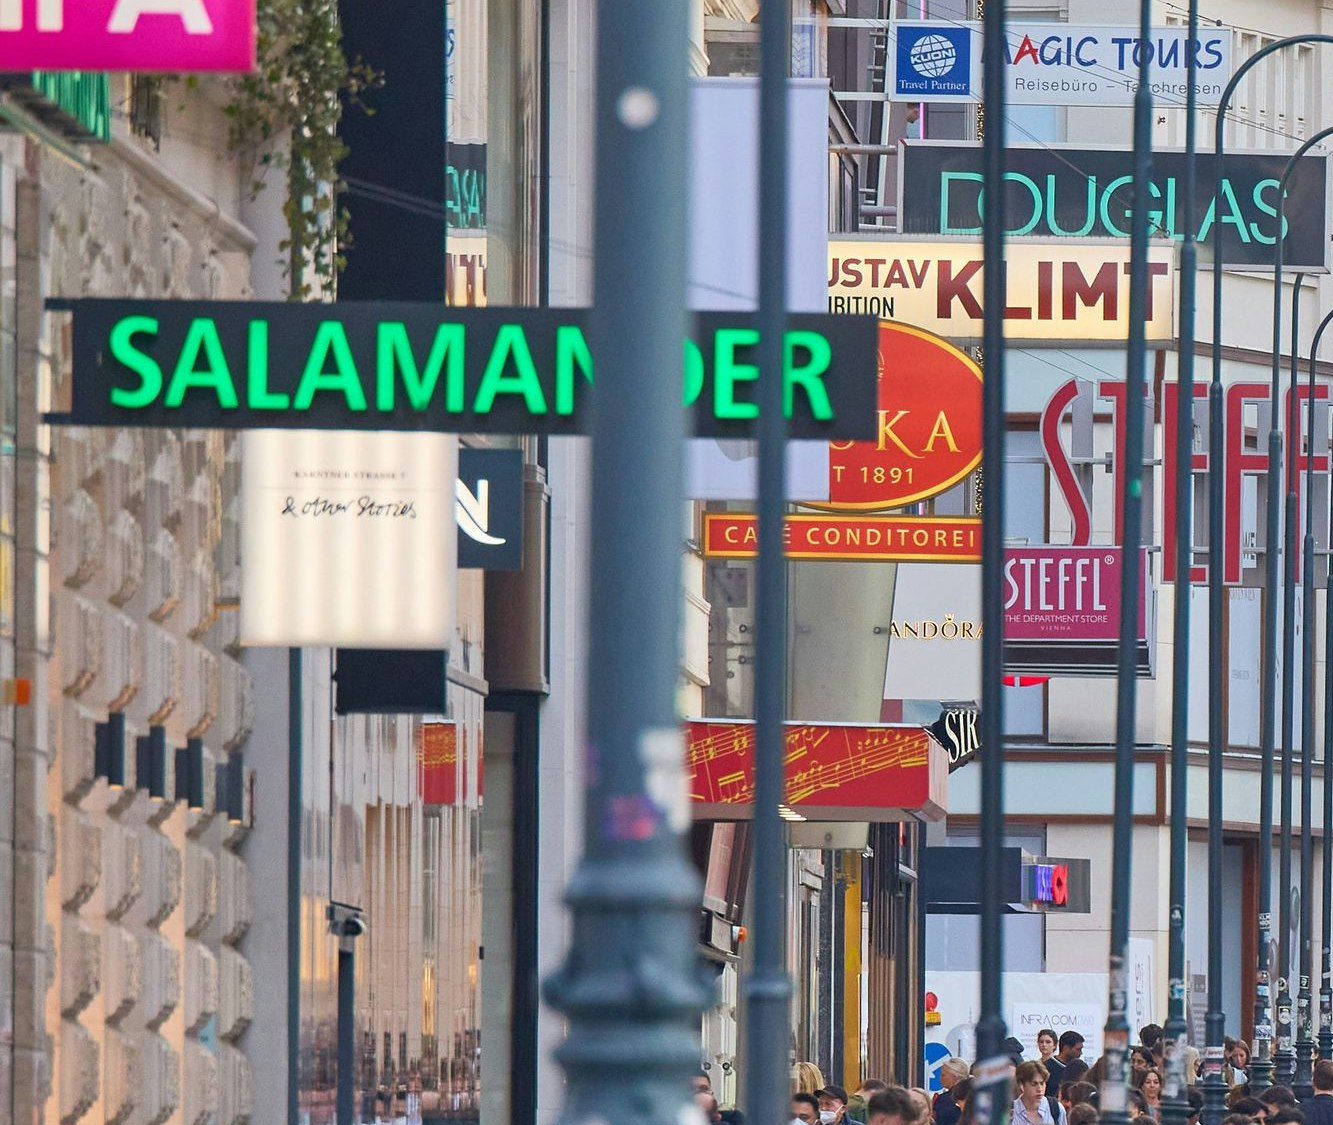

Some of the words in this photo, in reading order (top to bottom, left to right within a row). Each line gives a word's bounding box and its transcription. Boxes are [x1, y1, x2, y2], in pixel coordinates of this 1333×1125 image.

[910, 47, 956, 65] KUONI
[1111, 38, 1222, 69] TOURS
[899, 79, 928, 90] Travel
[931, 80, 966, 91] Partner
[1016, 78, 1097, 92] Reisebüro
[1124, 80, 1221, 95] Tachresen
[940, 172, 1288, 246] DOUGLAS
[861, 467, 913, 485] 1891
[724, 523, 792, 544] CAÉ
[806, 527, 975, 548] CONDITOREI
[1003, 558, 1107, 611] STEFFL
[1004, 614, 1021, 623] THE
[1023, 614, 1079, 624] DEPARTMENT
[1081, 614, 1108, 624] STORE
[890, 619, 984, 640] ANDOR
